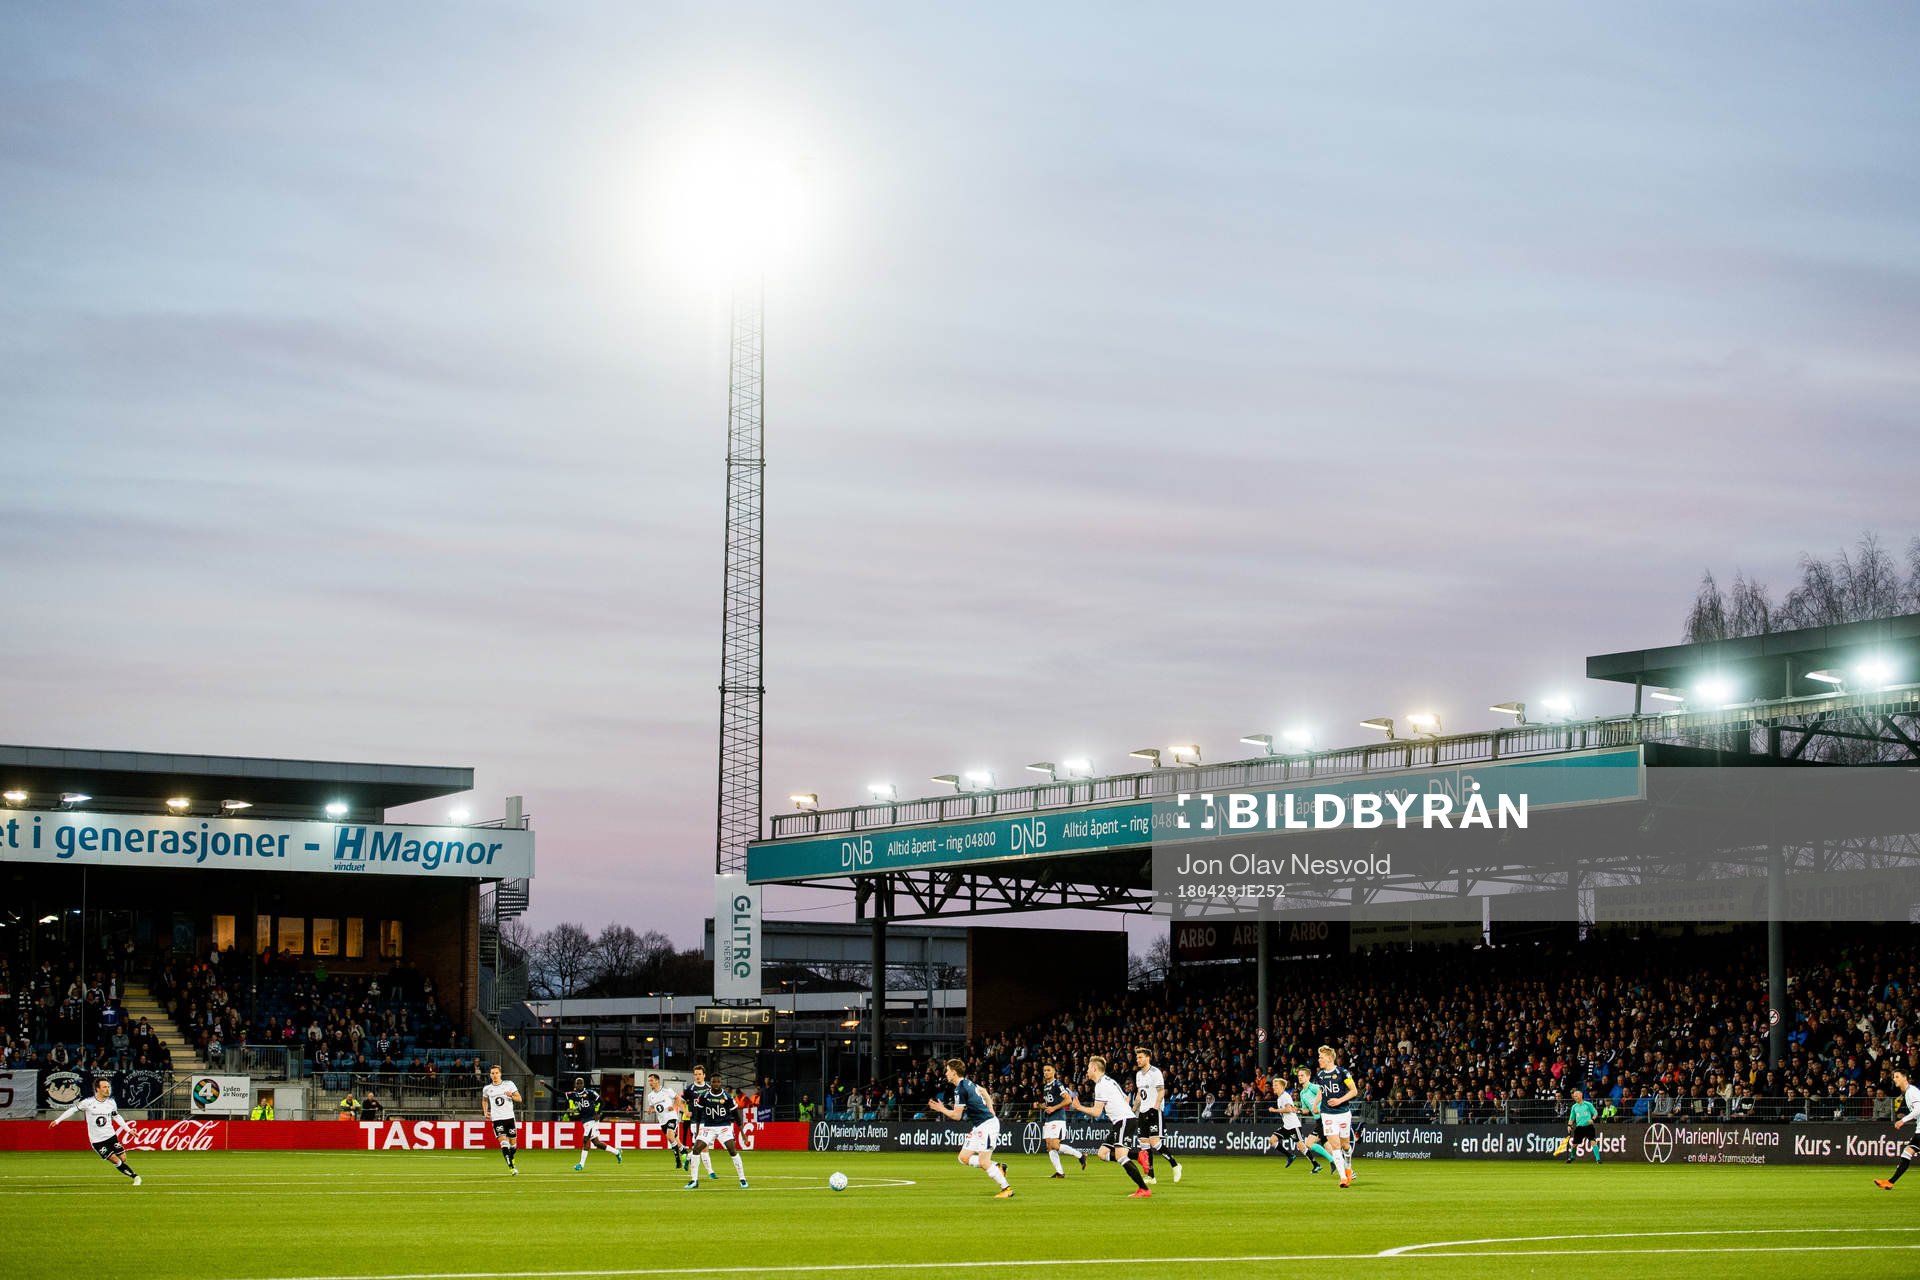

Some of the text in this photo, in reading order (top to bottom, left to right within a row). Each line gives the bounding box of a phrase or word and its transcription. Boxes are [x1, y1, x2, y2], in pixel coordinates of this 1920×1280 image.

[1011, 816, 1046, 855] DNB
[1063, 820, 1088, 838] Alltid
[1090, 818, 1119, 839] åpent
[1130, 815, 1149, 834] ring
[33, 815, 41, 848] i
[55, 822, 290, 864] generasjoner
[369, 831, 502, 870] Magnor
[841, 835, 873, 871] DNB
[887, 838, 910, 856] Alltid
[911, 837, 937, 857] åpent
[946, 835, 963, 853] ring
[965, 831, 996, 848] 04800
[333, 863, 365, 872] vinduet
[1178, 928, 1216, 949] ARBO
[1232, 925, 1259, 945] ARB
[1290, 921, 1329, 942] ARBO
[723, 939, 731, 971] ENERGI
[721, 1031, 760, 1047] 3:57
[705, 1104, 727, 1119] DNB
[115, 1119, 220, 1151] Coca-Cola
[359, 1121, 486, 1150] TASTE
[830, 1124, 888, 1141] Marienlyst Arena
[900, 1133, 912, 1146] en
[913, 1129, 929, 1146] del
[930, 1133, 943, 1146] av
[944, 1129, 1012, 1146] Strøset
[1164, 1131, 1217, 1149] nferanse
[1226, 1131, 1271, 1154] Selskap
[1412, 1127, 1443, 1144] Arena
[1461, 1136, 1478, 1152] en
[1481, 1133, 1503, 1153] del
[1506, 1137, 1523, 1153] av
[1675, 1127, 1779, 1149] Marienlyst Arena
[1795, 1134, 1831, 1156] Kurs
[1688, 1154, 1697, 1162] en
[1697, 1153, 1708, 1163] del
[1708, 1154, 1717, 1163] av
